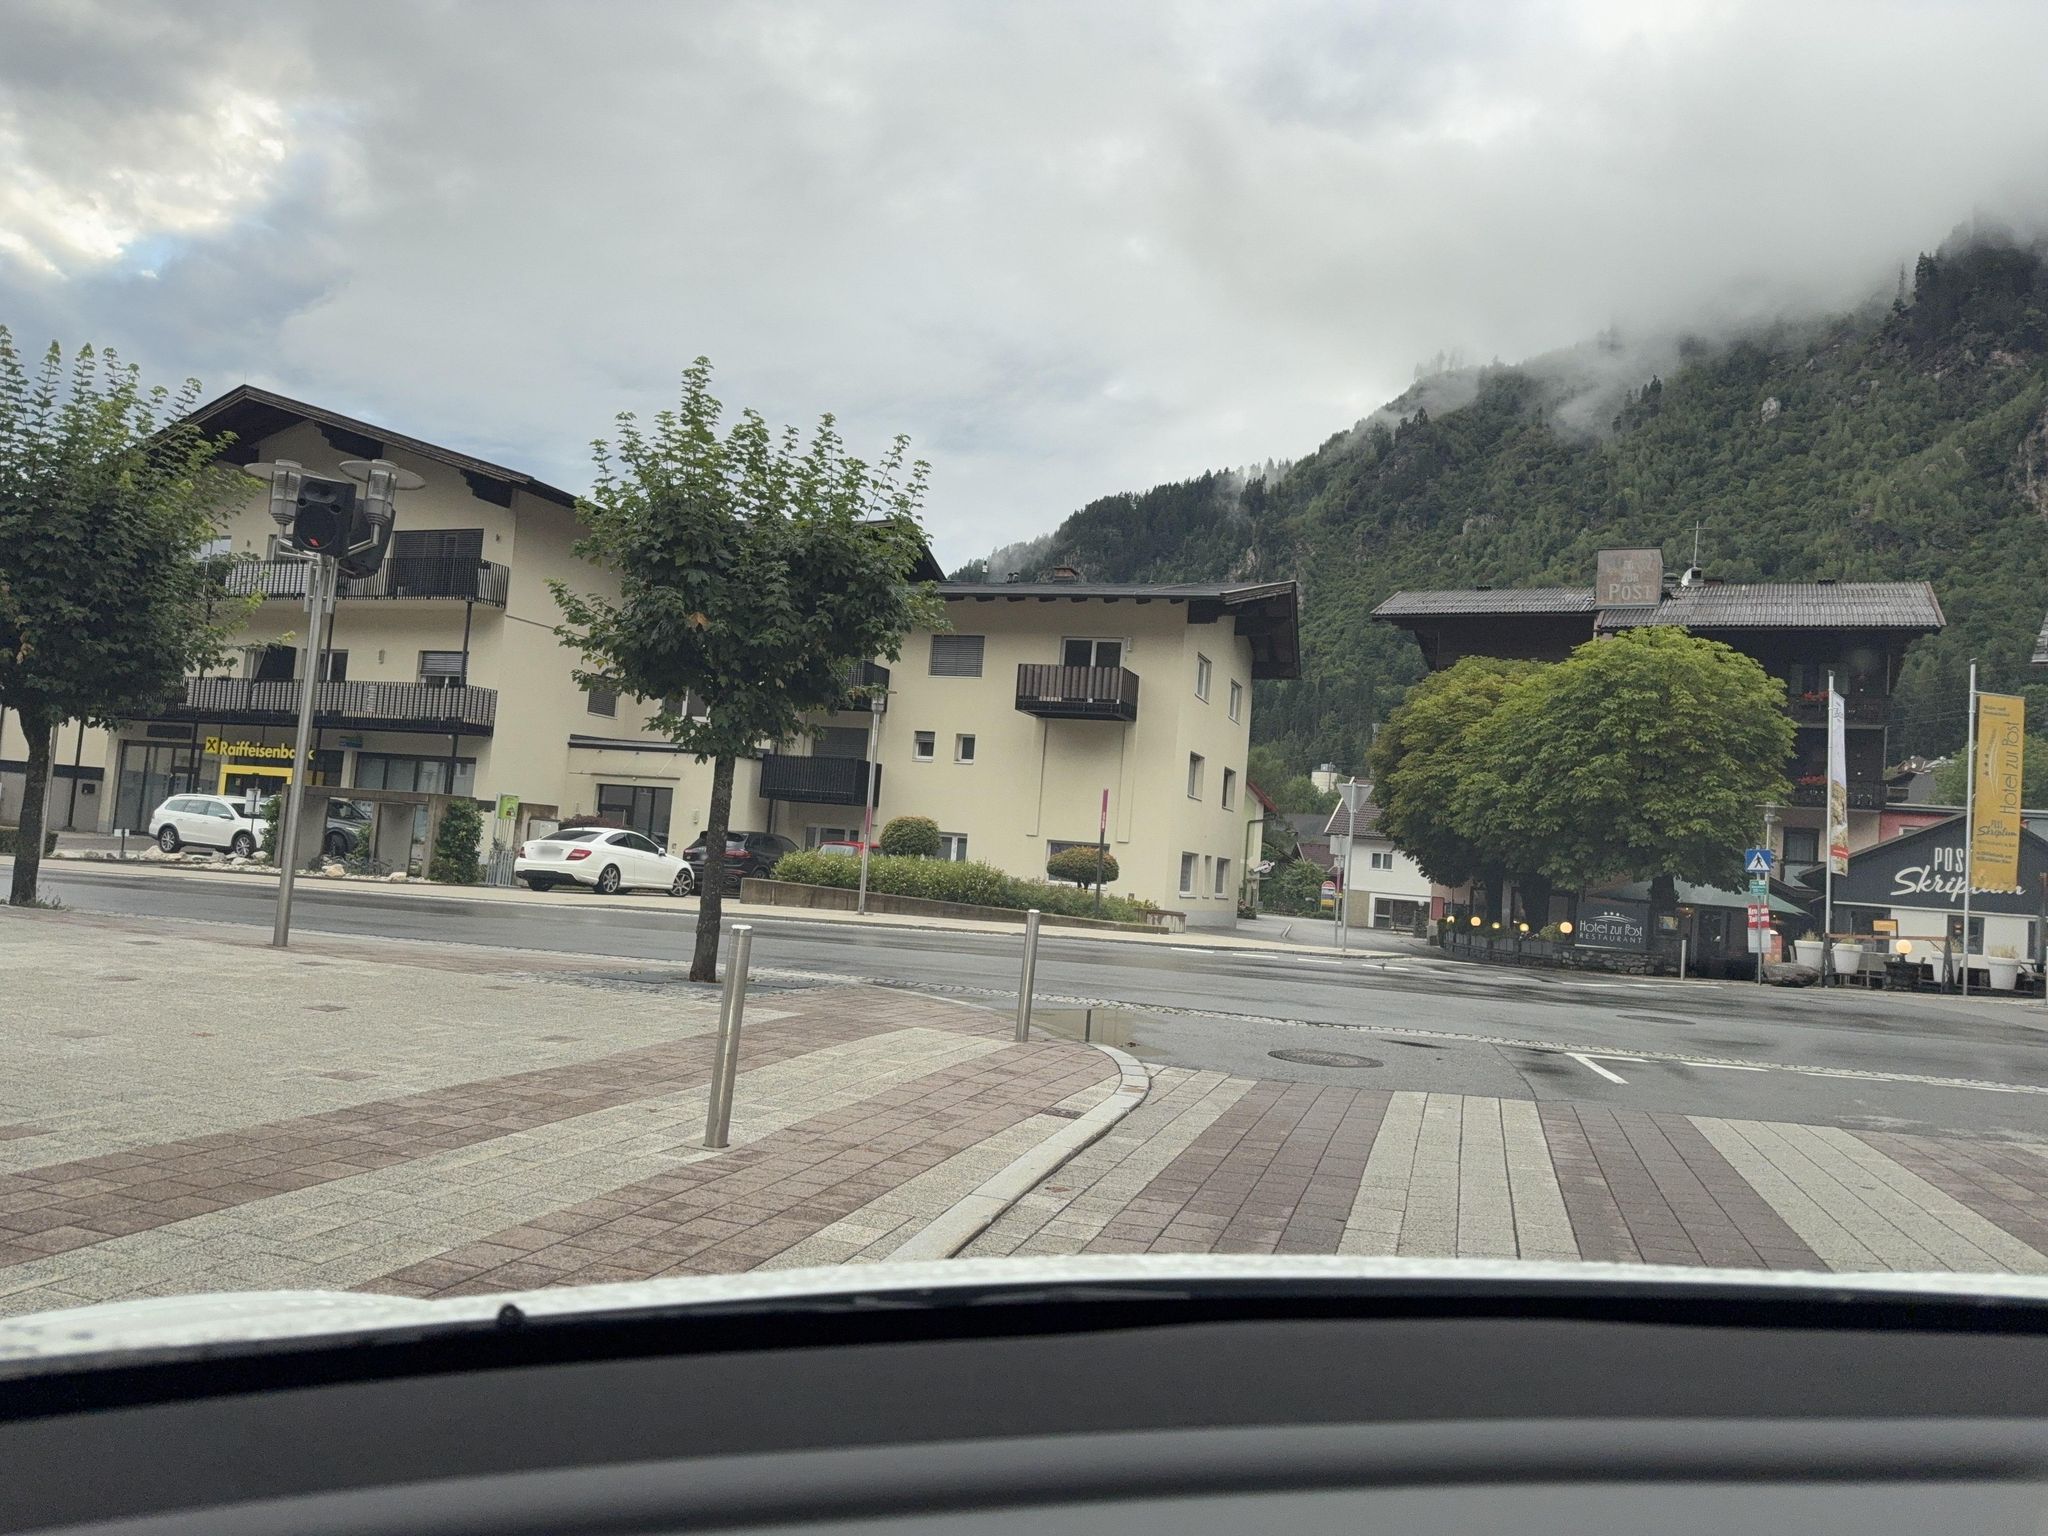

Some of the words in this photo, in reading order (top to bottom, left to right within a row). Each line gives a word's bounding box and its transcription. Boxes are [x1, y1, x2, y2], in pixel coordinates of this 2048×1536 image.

[1609, 583, 1654, 601] POST
[2002, 722, 2020, 749] Post
[219, 740, 315, 760] Raiffeisenbak
[2005, 751, 2019, 769] zur
[2000, 773, 2018, 815] Hotel
[1934, 847, 1966, 873] POS
[1890, 865, 2026, 902] Skrip
[1579, 932, 1642, 944] RESTAURANT
[1580, 920, 1607, 934] Hotel
[1609, 925, 1622, 935] zur
[1625, 924, 1643, 937] Post
